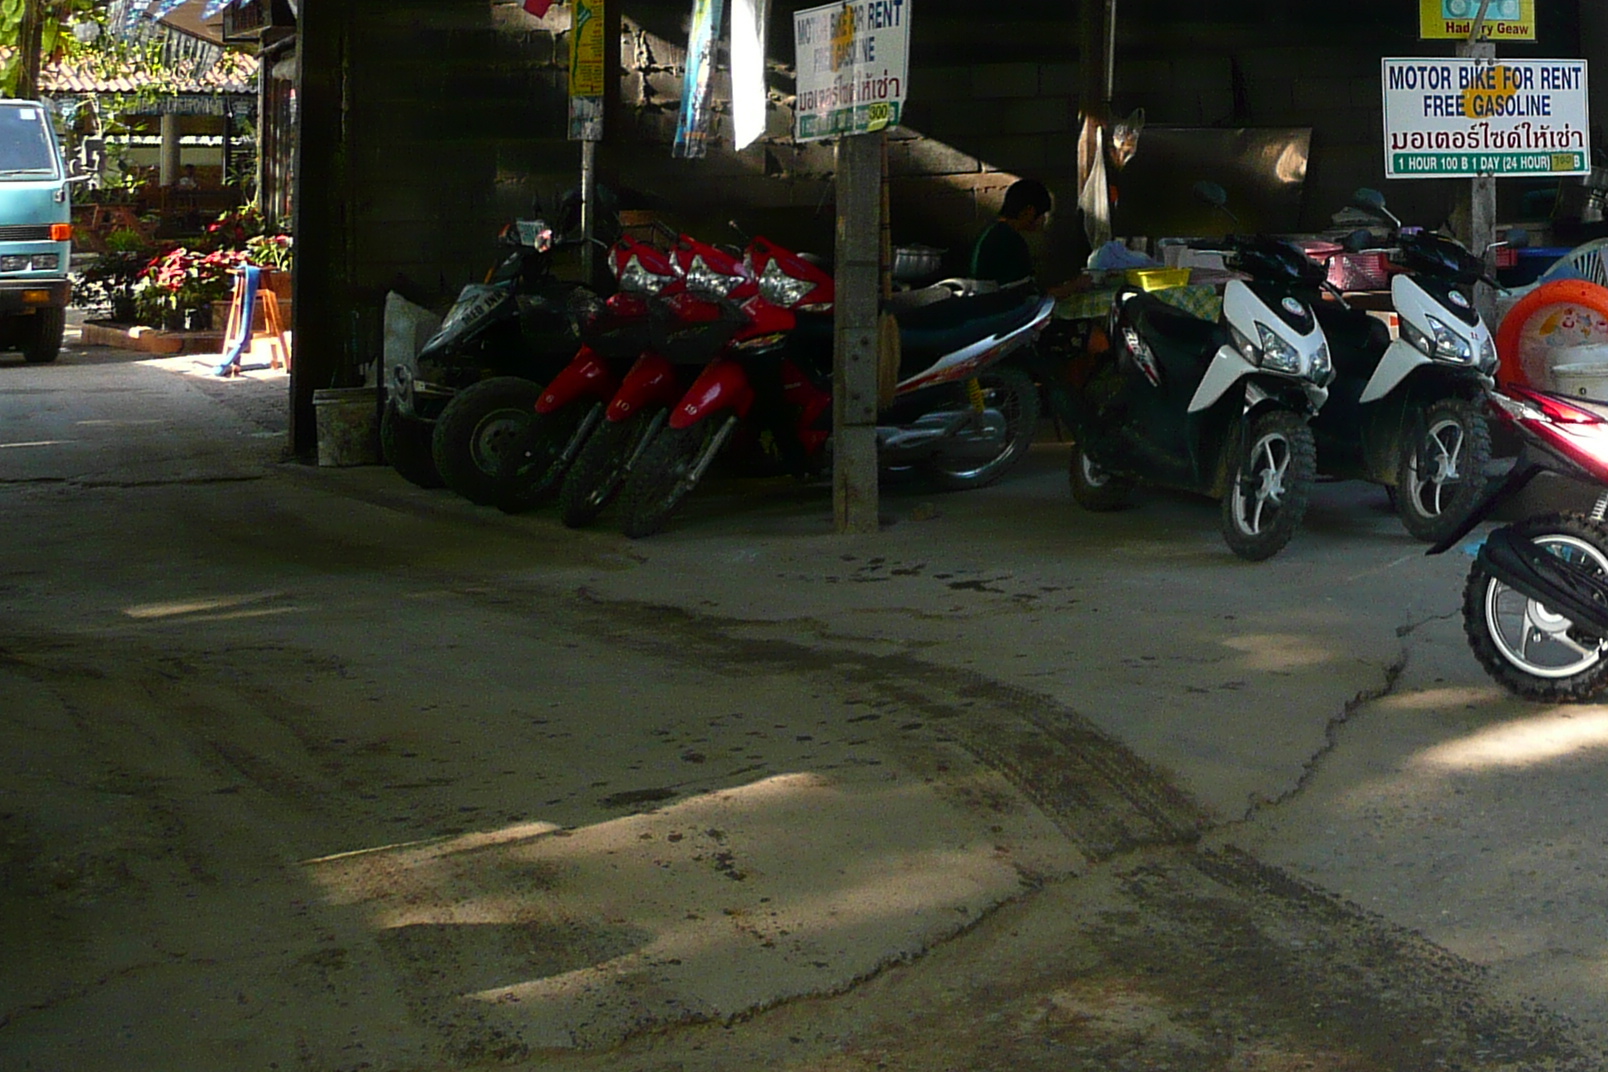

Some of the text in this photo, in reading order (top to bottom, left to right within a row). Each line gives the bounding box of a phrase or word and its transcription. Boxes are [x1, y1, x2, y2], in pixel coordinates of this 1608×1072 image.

[1496, 22, 1529, 35] Geaw
[1389, 65, 1582, 90] MOTOR BIKE FOR RENT
[869, 104, 888, 120] 300
[1423, 95, 1552, 117] FREE GASOLINE
[1398, 158, 1404, 170] 1
[1408, 157, 1437, 170] HOUR
[1441, 157, 1458, 170] 100
[1461, 158, 1469, 170] B
[1472, 158, 1477, 170] 1
[1480, 158, 1500, 170] DAY
[1502, 157, 1518, 171] (24
[1520, 157, 1551, 171] HOUR)
[1573, 156, 1581, 168] B
[615, 398, 630, 412] 10
